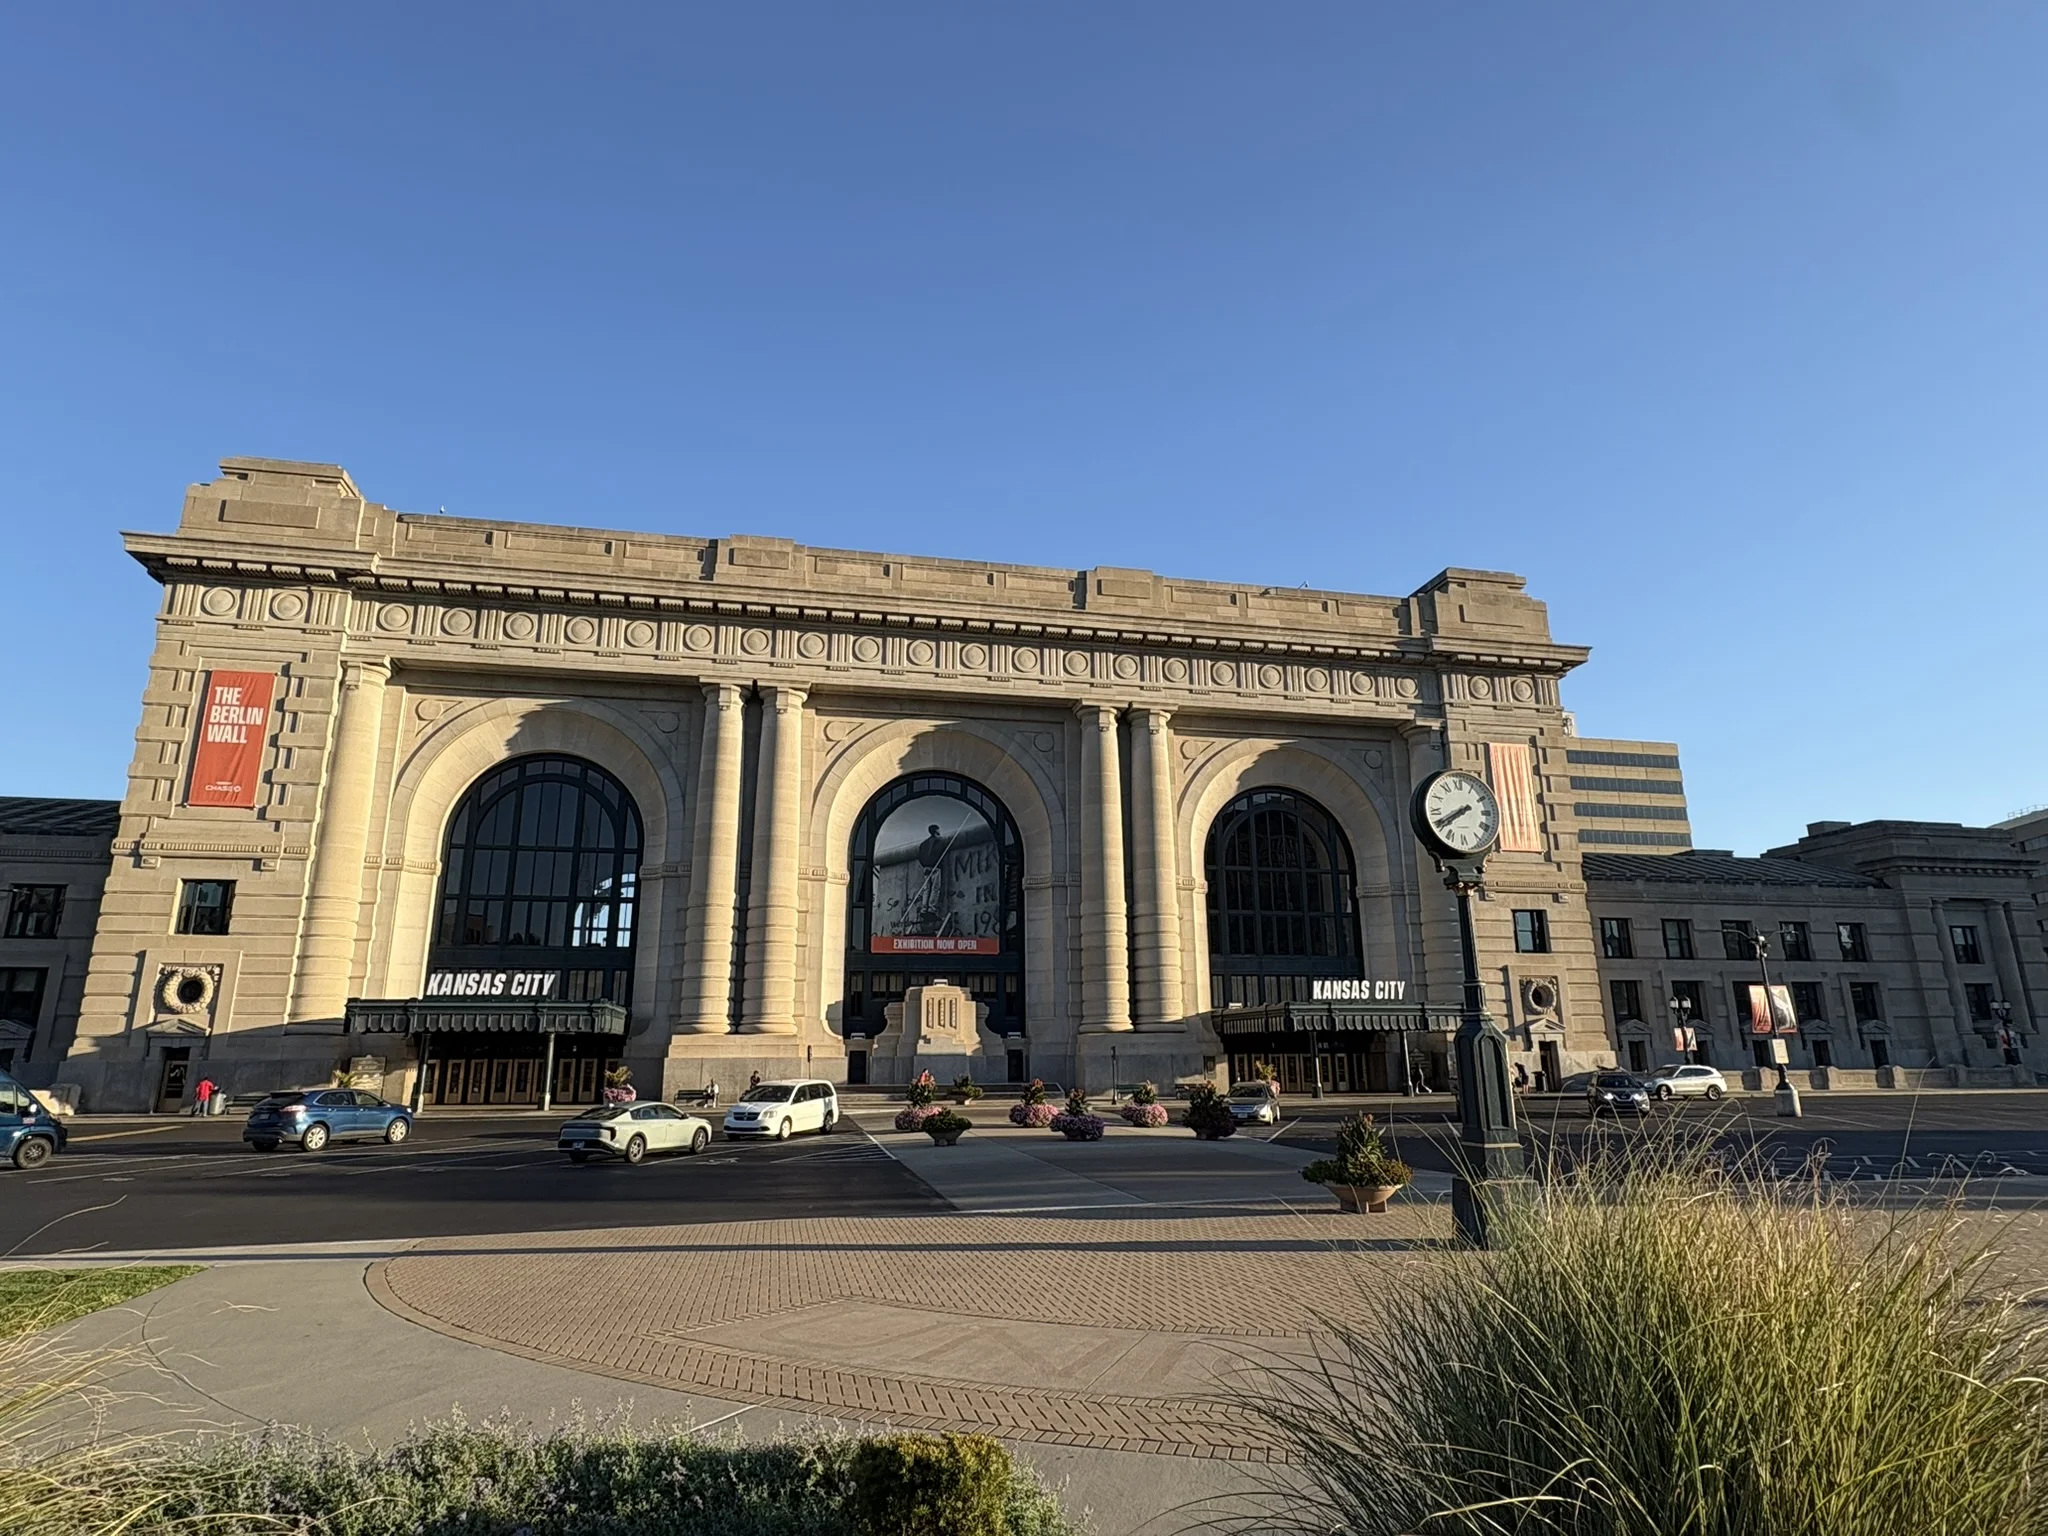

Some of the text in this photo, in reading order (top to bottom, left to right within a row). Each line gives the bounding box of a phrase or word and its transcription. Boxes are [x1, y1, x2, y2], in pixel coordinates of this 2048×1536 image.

[215, 686, 243, 705] THE
[209, 705, 264, 725] BERLIN
[207, 724, 248, 744] WALL
[893, 939, 977, 950] EXHIBITION NOW OPEN
[426, 973, 556, 996] KANSAS CITY
[1313, 980, 1406, 1000] KANSAS CITY
